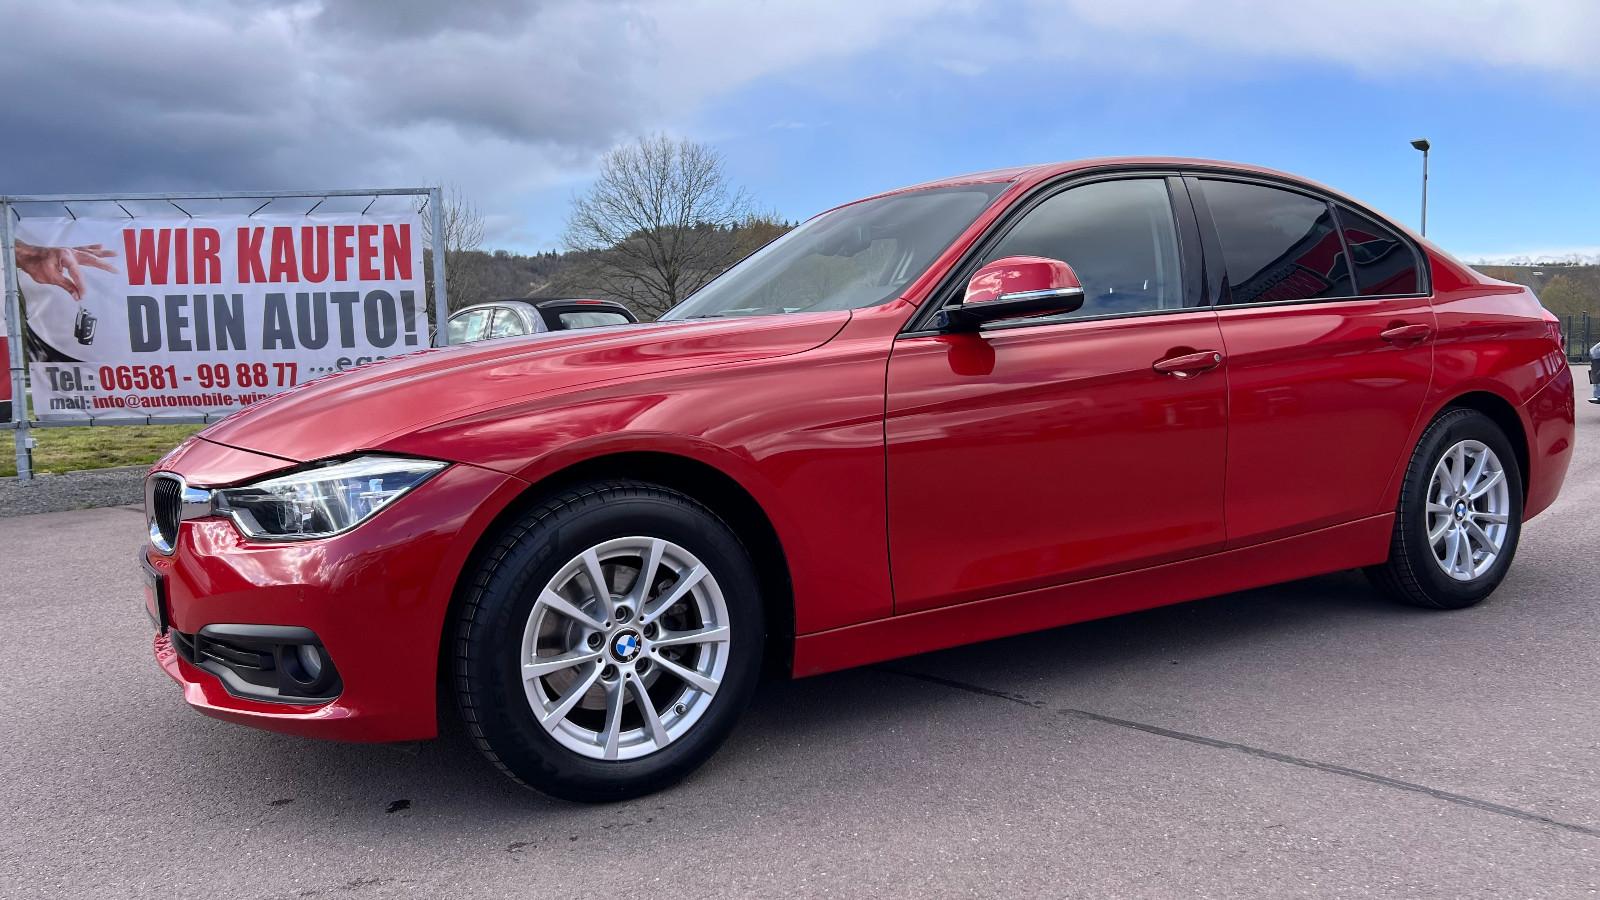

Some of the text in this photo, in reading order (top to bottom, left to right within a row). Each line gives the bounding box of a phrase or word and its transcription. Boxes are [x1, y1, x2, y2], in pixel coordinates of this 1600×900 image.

[122, 223, 413, 286] WIR KAUFEN
[126, 289, 418, 353] DEIN AUTO!
[46, 366, 96, 392] Tel.:
[98, 364, 179, 391] 06581
[197, 363, 231, 389] 99
[236, 363, 269, 388] 88
[272, 362, 298, 387] 77
[49, 392, 269, 410] mail: info@automobile-wi
